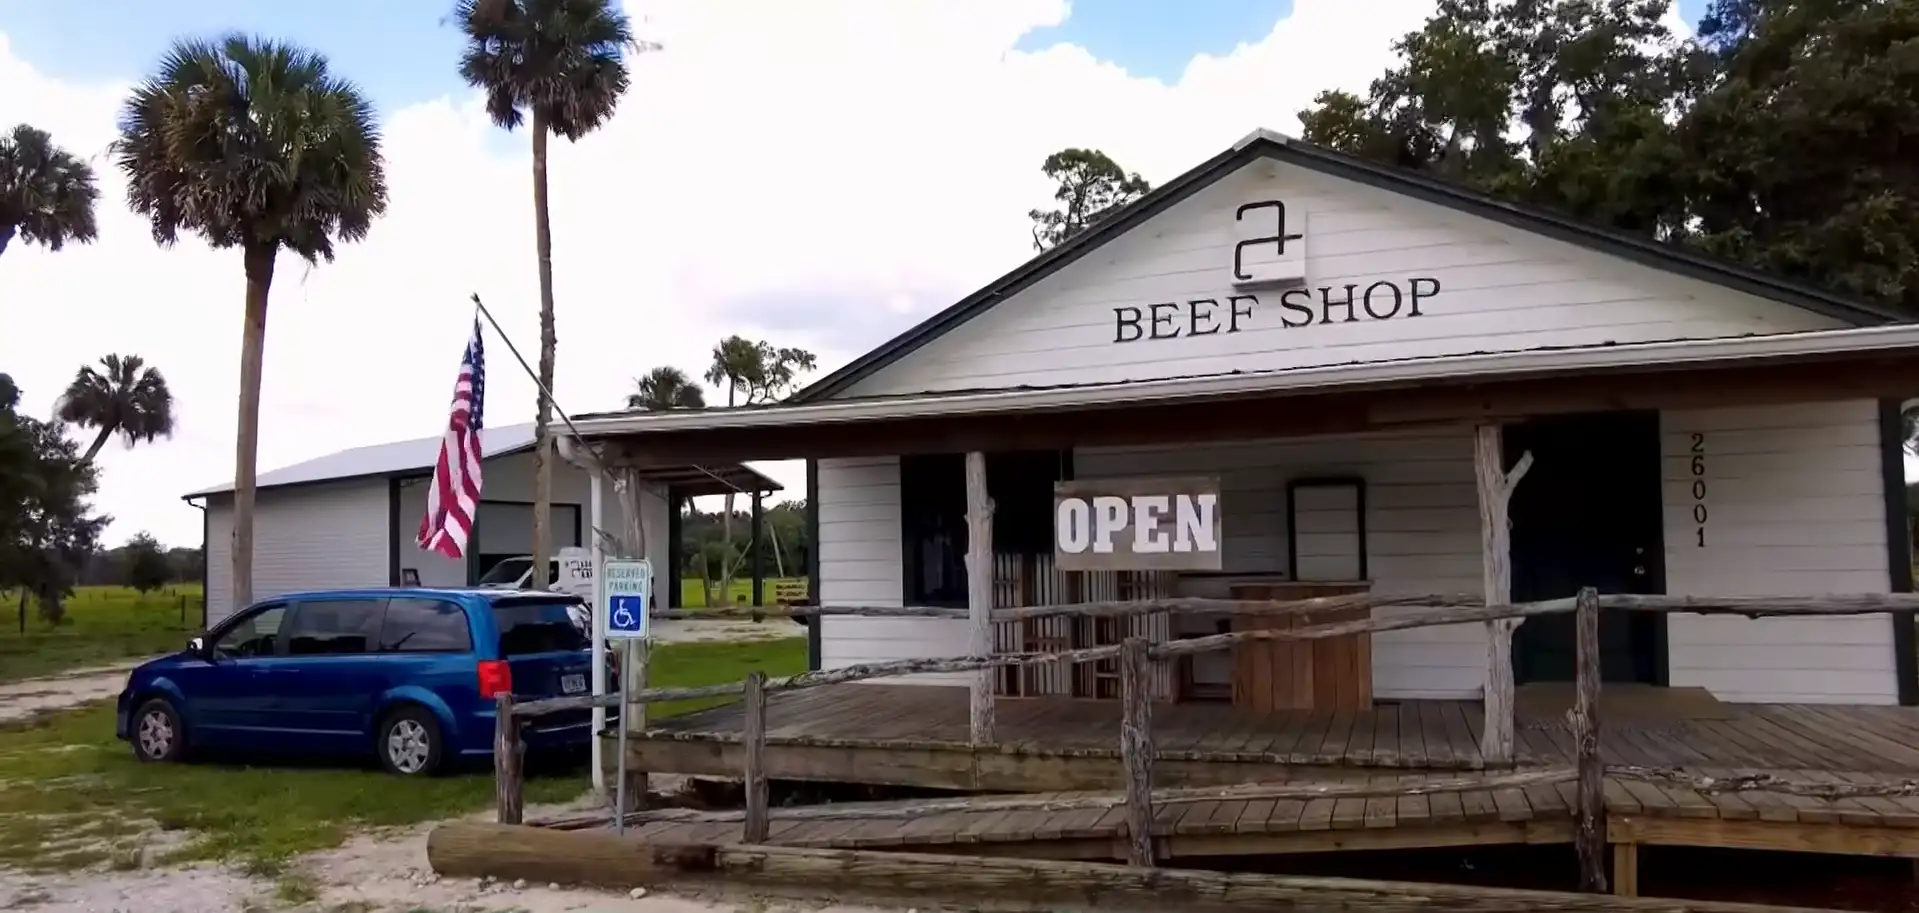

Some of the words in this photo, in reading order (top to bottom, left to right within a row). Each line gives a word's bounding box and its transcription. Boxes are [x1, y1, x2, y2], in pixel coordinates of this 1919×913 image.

[1113, 295, 1259, 343] BEEF
[1281, 278, 1441, 328] SHOP
[1691, 433, 1707, 547] 26001
[1057, 494, 1217, 554] OPEN
[607, 568, 646, 579] RESERVED
[609, 581, 643, 592] PARKING
